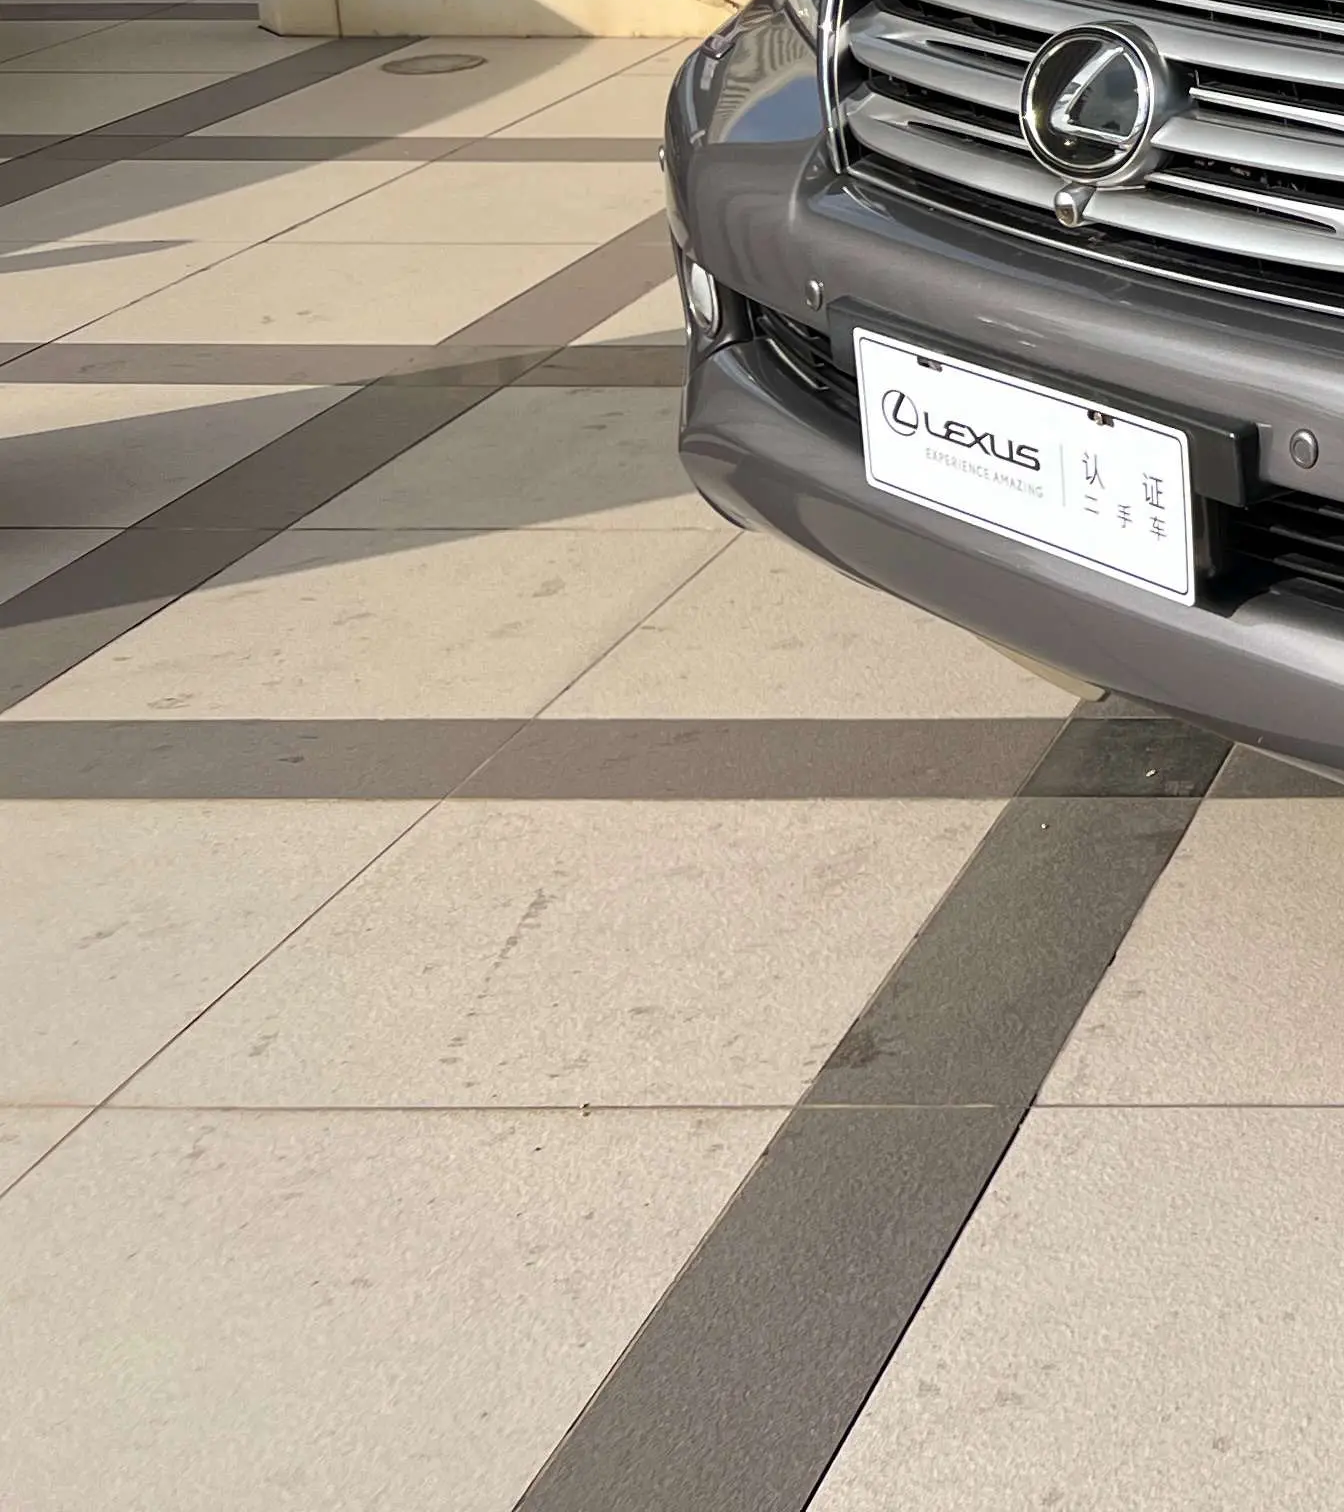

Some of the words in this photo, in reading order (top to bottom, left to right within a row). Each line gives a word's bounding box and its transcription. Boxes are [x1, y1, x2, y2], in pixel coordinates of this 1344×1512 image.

[922, 411, 1041, 472] LEXUS
[925, 446, 989, 481] EXPERIENCE
[992, 471, 1044, 500] AMAZING
[1081, 451, 1165, 510] 认证
[1084, 494, 1168, 542] 二手车
